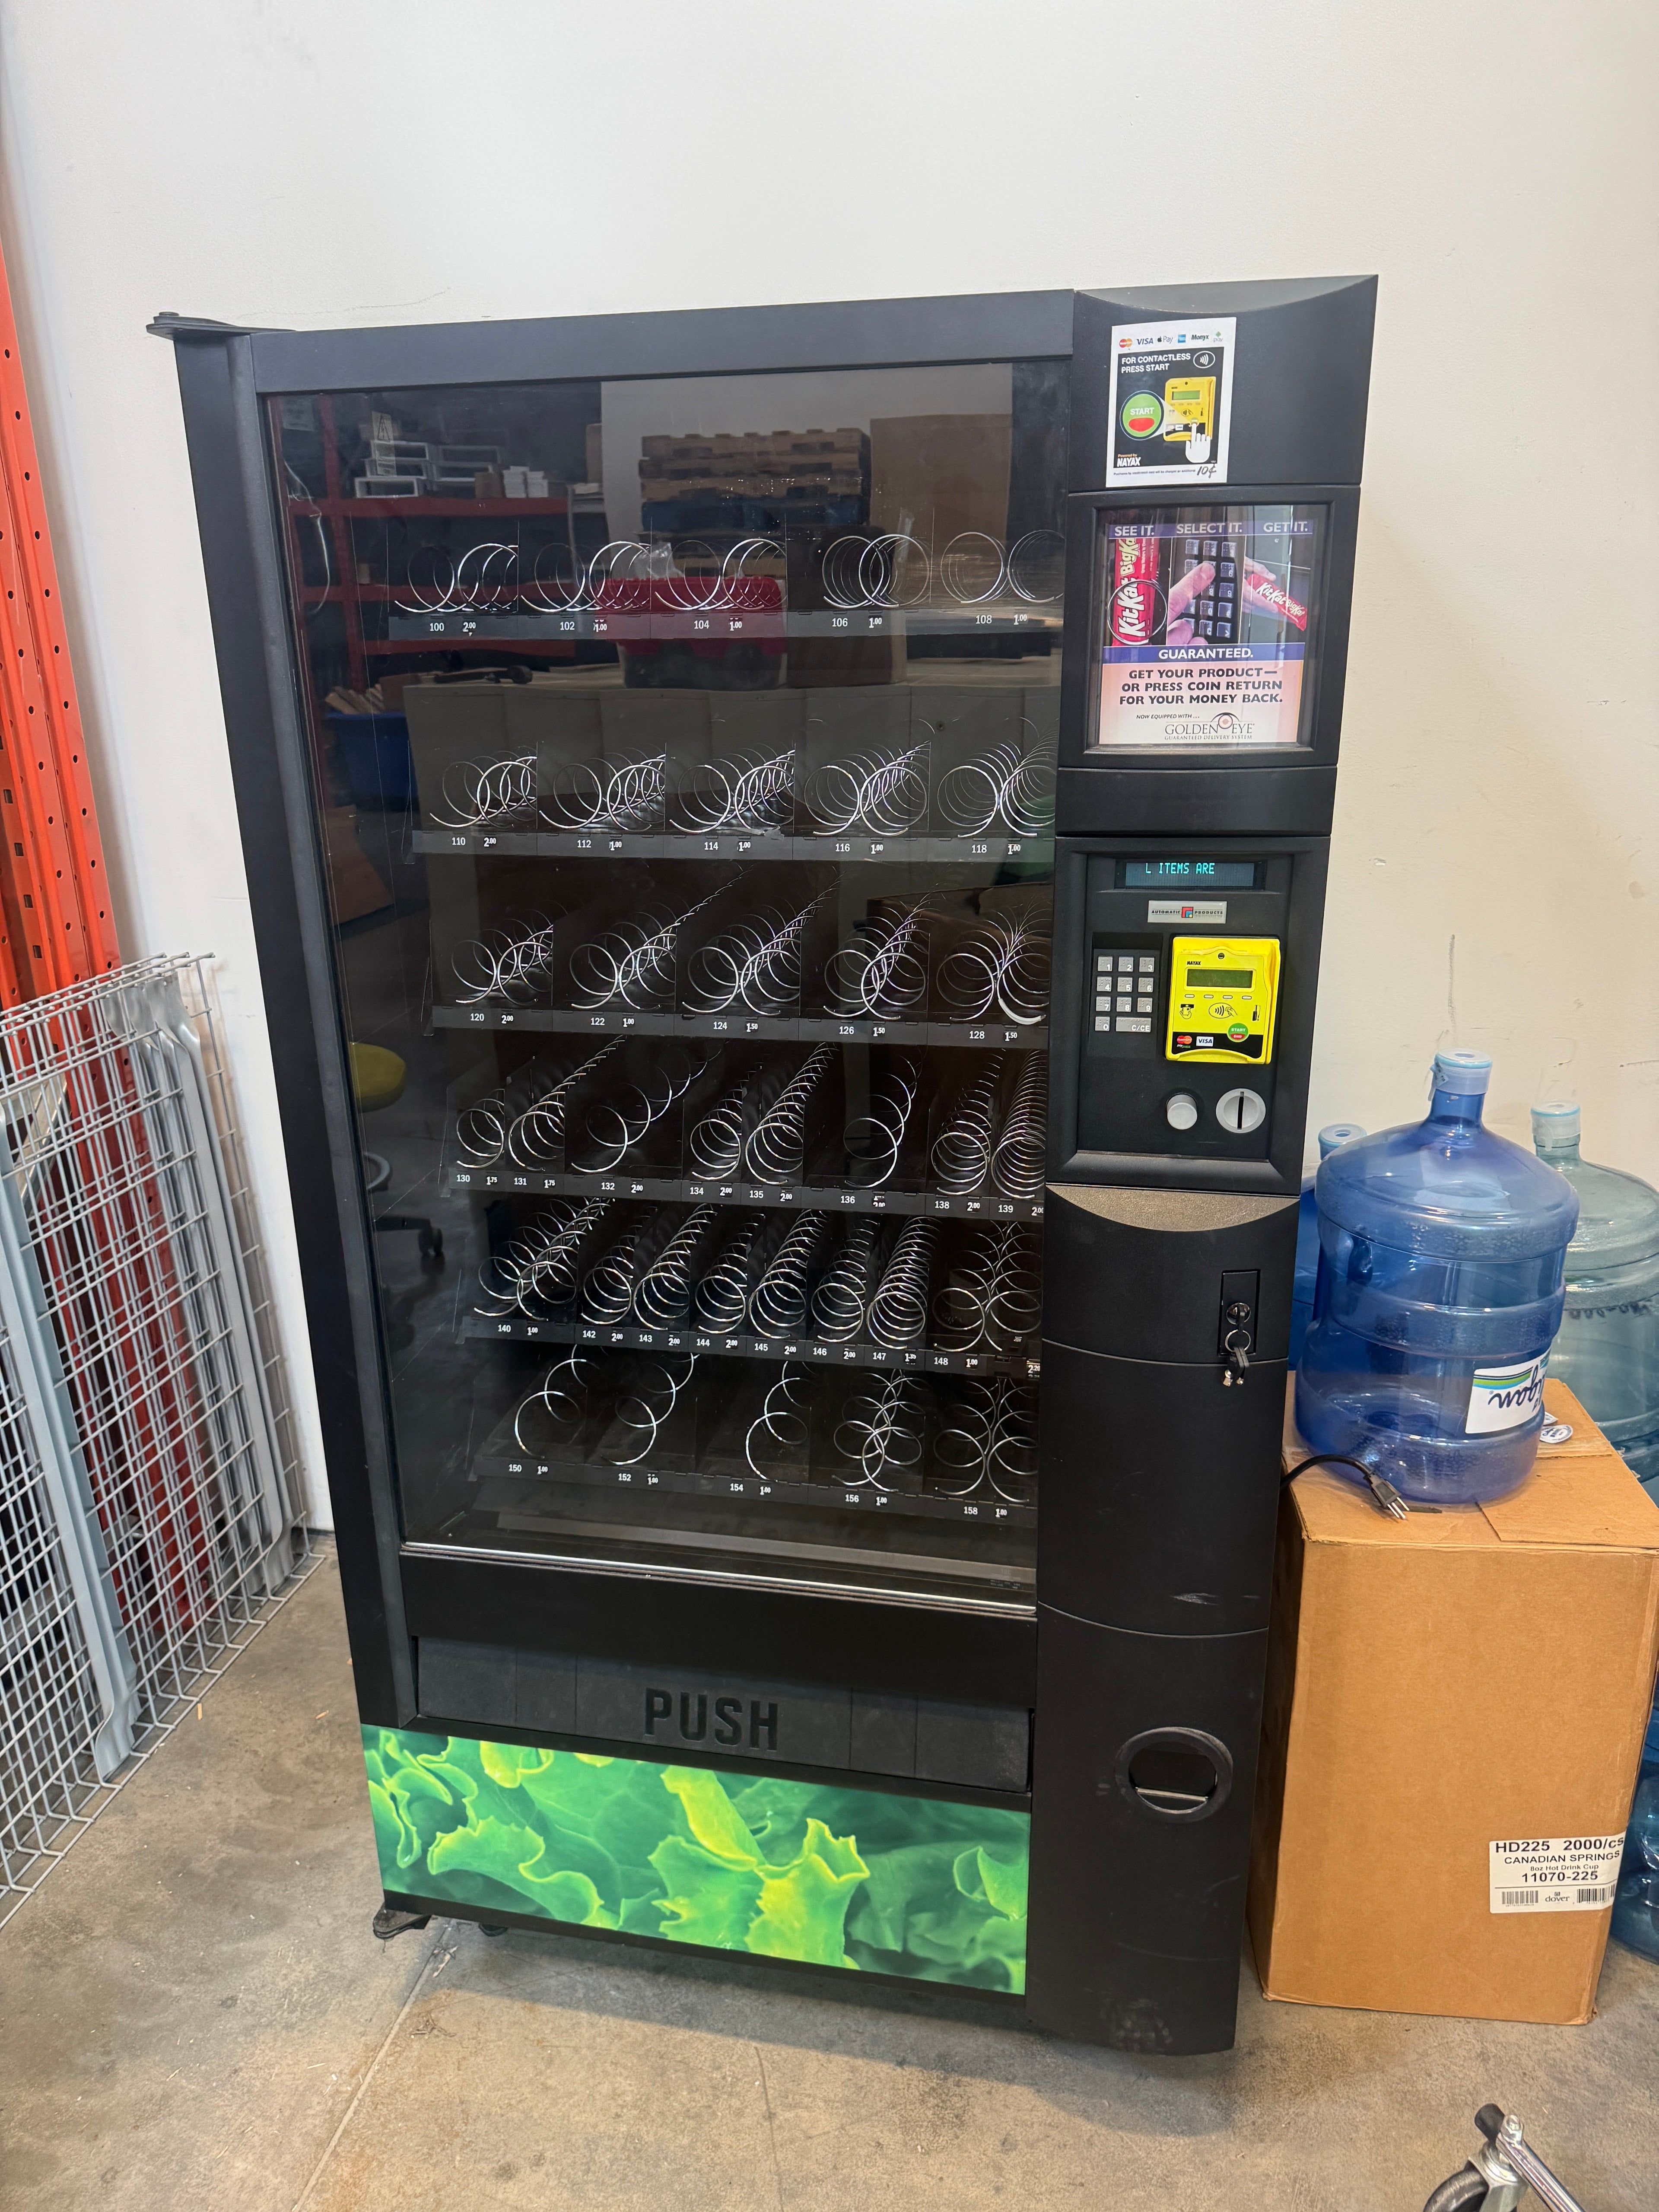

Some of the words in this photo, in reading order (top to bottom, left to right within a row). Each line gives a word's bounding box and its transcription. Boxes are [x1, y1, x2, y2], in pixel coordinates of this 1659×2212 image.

[1138, 353, 1191, 363] CONTACTLESS
[1146, 363, 1170, 372] START
[1117, 457, 1141, 467] NAYAX
[1115, 526, 1139, 536] SEE
[1141, 525, 1154, 536] IT.
[1176, 524, 1224, 534] SELECT
[1228, 523, 1242, 533] IT.
[1263, 522, 1291, 532] GET
[1294, 521, 1308, 532] IT.
[832, 618, 848, 627] 106
[976, 614, 992, 624] 108
[430, 623, 445, 631] 100
[560, 621, 575, 630] 102
[694, 620, 709, 629] 104
[1159, 648, 1253, 659] GUARANTEED.
[1129, 670, 1154, 679] GET
[1158, 669, 1194, 678] YOUR
[1122, 683, 1140, 692] OR
[1145, 682, 1182, 691] PRESS
[1188, 682, 1221, 691] COIN
[1226, 681, 1282, 690] RETURN
[1119, 696, 1144, 705] FOR
[1148, 695, 1184, 704] YOUR
[1189, 694, 1237, 703] MONEY
[1242, 693, 1283, 703] BACK.
[1165, 724, 1219, 734] GOLDEN
[452, 837, 466, 845] 110
[577, 839, 591, 848] 112
[704, 842, 718, 850] 114
[836, 843, 850, 852] 116
[972, 844, 987, 853] 118
[1146, 863, 1151, 874] L
[1159, 863, 1189, 874] ITEMS
[1196, 863, 1215, 874] ARE
[470, 1013, 484, 1021] 120
[591, 1017, 605, 1026] 122
[713, 1021, 728, 1030] 124
[839, 1026, 854, 1034] 126
[969, 1030, 985, 1039] 128
[457, 1174, 470, 1182] 130
[514, 1177, 527, 1185] 131
[601, 1182, 615, 1190] 132
[690, 1187, 704, 1195] 134
[750, 1190, 764, 1198] 135
[841, 1195, 855, 1204] 136
[935, 1201, 950, 1209] 138
[998, 1205, 1014, 1213] 139
[498, 1324, 511, 1332] 140
[583, 1330, 596, 1338] 142
[639, 1334, 652, 1342] 143
[696, 1338, 710, 1347] 144
[754, 1343, 768, 1351] 145
[813, 1347, 827, 1356] 146
[873, 1352, 886, 1360] 147
[934, 1357, 948, 1365] 148
[509, 1464, 522, 1472] 150
[618, 1473, 631, 1481] 152
[730, 1483, 744, 1491] 154
[845, 1494, 859, 1503] 156
[964, 1506, 978, 1515] 158
[645, 1688, 778, 1751] PUSH
[1495, 1840, 1550, 1853] HD225
[1504, 1855, 1566, 1864] CANADIAN
[1570, 1850, 1620, 1862] SPRINGS
[1522, 1871, 1598, 1882] 11070-225
